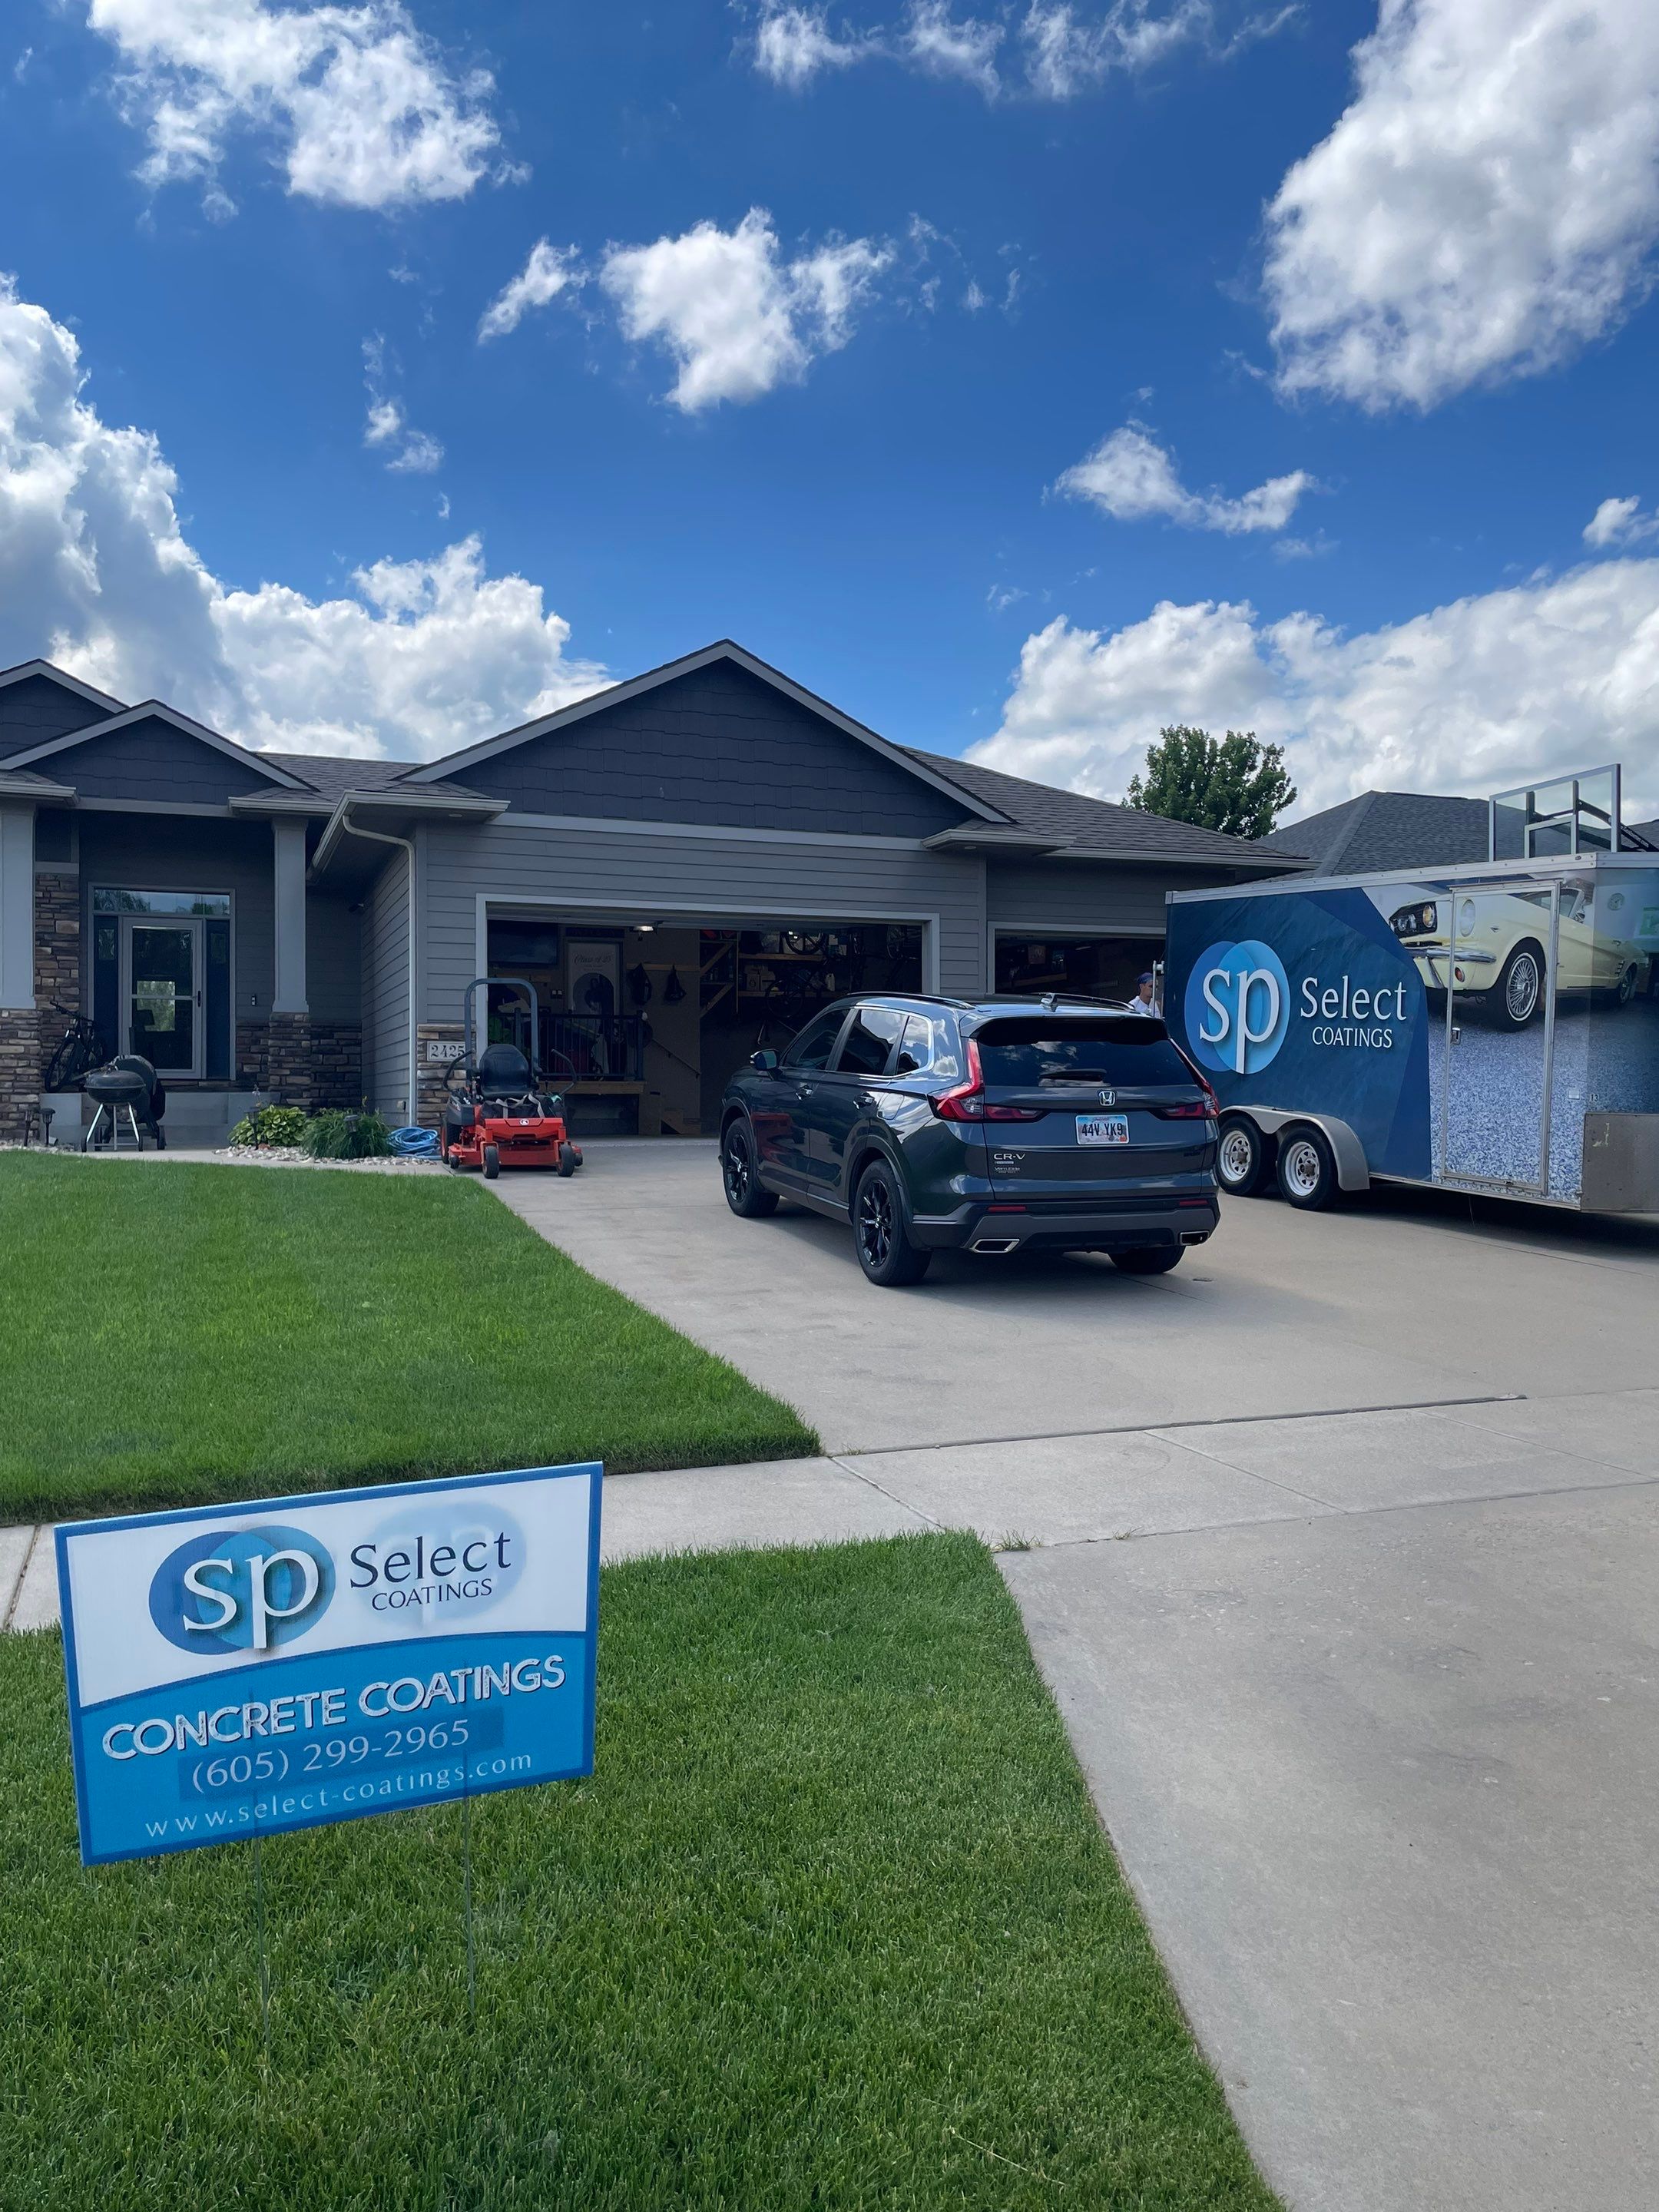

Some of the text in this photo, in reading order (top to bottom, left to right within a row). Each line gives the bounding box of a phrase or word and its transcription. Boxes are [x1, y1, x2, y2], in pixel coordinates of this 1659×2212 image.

[1199, 968, 1280, 1075] sp
[1300, 975, 1407, 1022] Select
[431, 1045, 465, 1058] 2425
[1312, 1026, 1392, 1048] COATINGS
[1081, 1123, 1123, 1136] 44V YK9
[350, 1532, 512, 1589] Select
[182, 1549, 319, 1649] sp
[372, 1578, 492, 1611] COATINGS
[101, 1654, 566, 1760] CONCRETE COATINGS
[192, 1719, 469, 1793] (605) 299-2965
[145, 1753, 531, 1837] www.select-coatings.com
